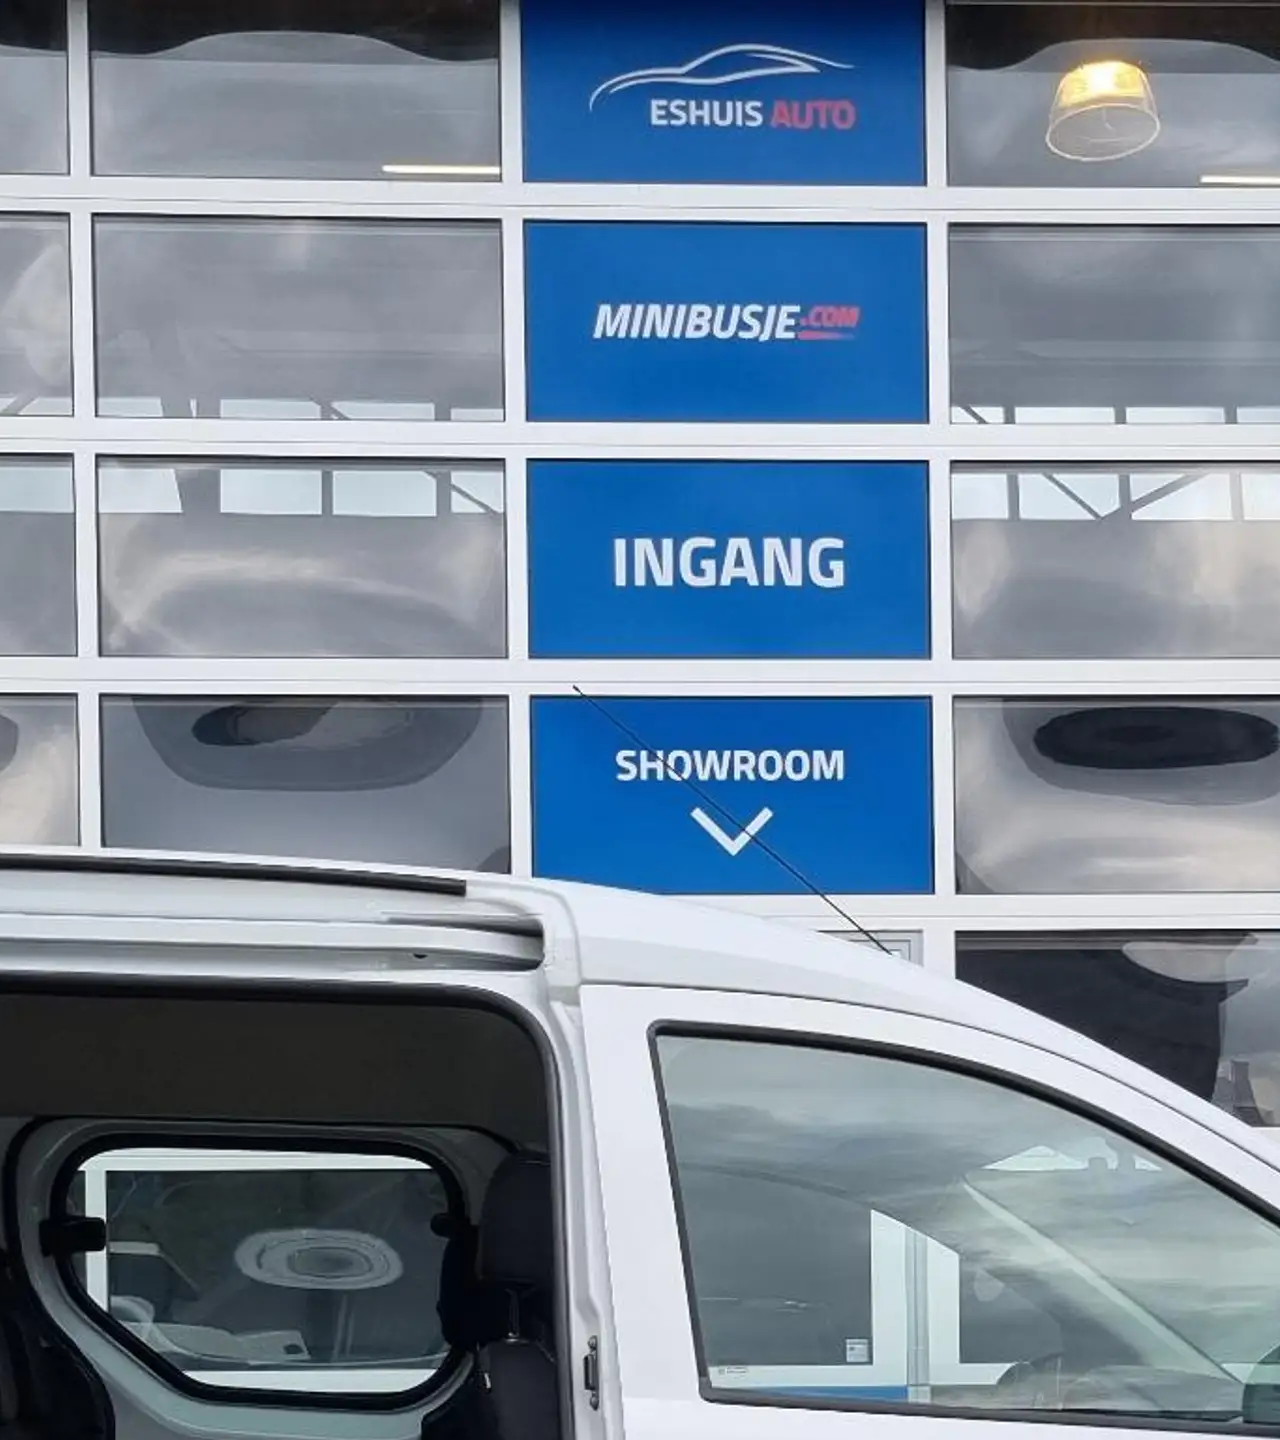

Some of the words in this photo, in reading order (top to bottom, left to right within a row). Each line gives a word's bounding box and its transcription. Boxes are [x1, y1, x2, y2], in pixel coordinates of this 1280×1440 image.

[650, 99, 763, 127] ESHUIS
[770, 99, 856, 129] AUTO
[614, 536, 845, 588] INGANG
[615, 749, 845, 782] SHOWROOM
